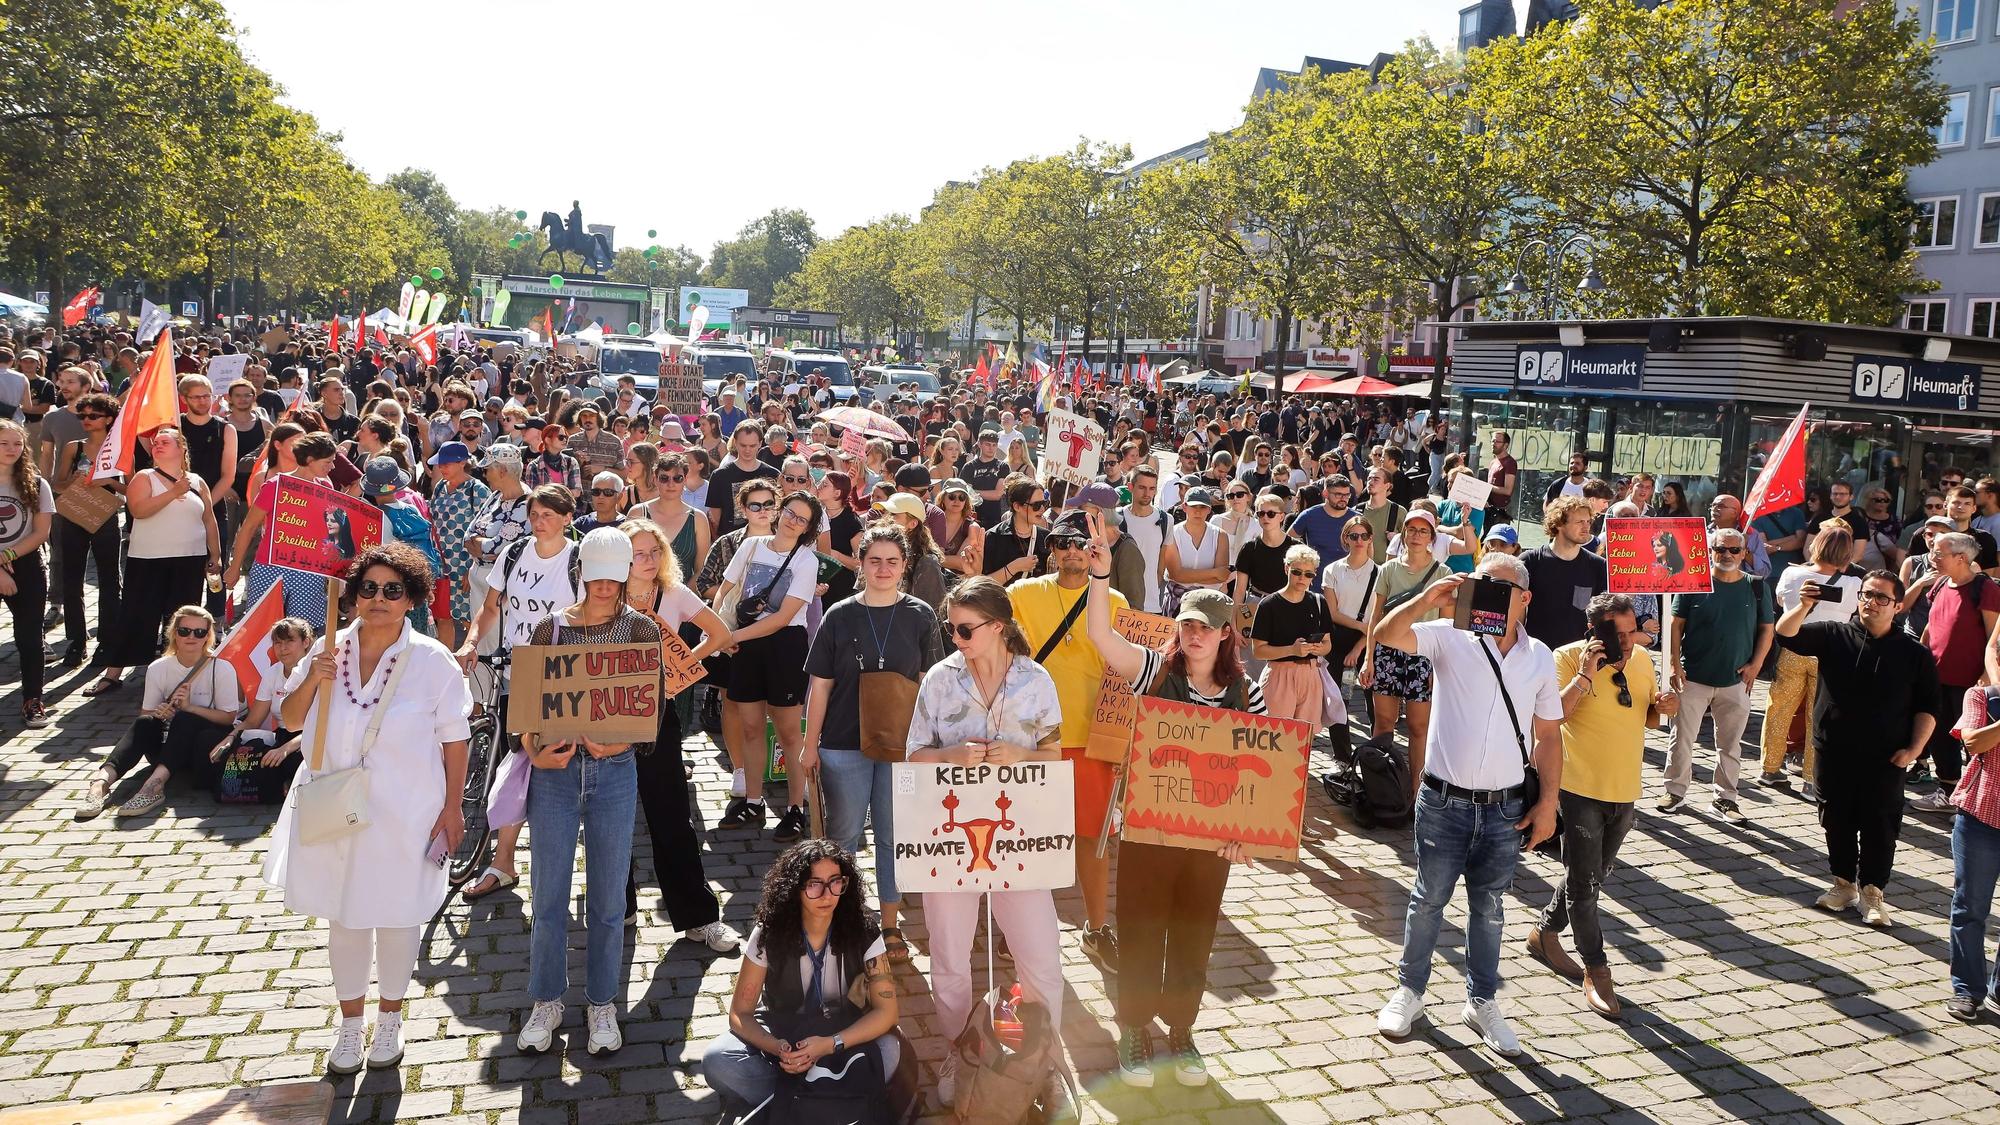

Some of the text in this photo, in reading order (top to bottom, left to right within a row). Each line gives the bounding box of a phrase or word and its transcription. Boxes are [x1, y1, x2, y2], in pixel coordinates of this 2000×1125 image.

[560, 286, 574, 295] für
[575, 287, 592, 297] das
[595, 289, 622, 298] Leben
[660, 364, 680, 376] GEGEN
[1571, 359, 1637, 375] Heumarkt
[1913, 376, 1974, 396] Heumarkt
[1052, 416, 1068, 428] MY
[1046, 459, 1061, 473] MY
[278, 491, 307, 507] Frau
[277, 511, 307, 527] Leben
[274, 530, 317, 550] Freiheit
[1609, 532, 1634, 542] Frau
[1693, 532, 1703, 542] زن
[1609, 548, 1636, 558] Leben
[1688, 546, 1707, 559] زندگی
[1610, 564, 1648, 576] Freiheit
[1688, 563, 1707, 575] آزادی
[516, 567, 544, 589] MY
[505, 596, 555, 615] ODY
[1117, 613, 1172, 634] FÜRS LE
[544, 648, 660, 679] MY UTERUS
[687, 661, 702, 675] IS
[542, 683, 656, 721] MY RULES
[1100, 694, 1130, 711] ARM
[1158, 721, 1283, 752] DON'T FUCK
[1149, 747, 1238, 770] WITH OUR
[936, 765, 991, 785] KEEP
[998, 764, 1046, 786] OUT!
[1149, 775, 1255, 805] FREEDOM!
[896, 834, 1075, 859] PRIVATE PROPERTY
